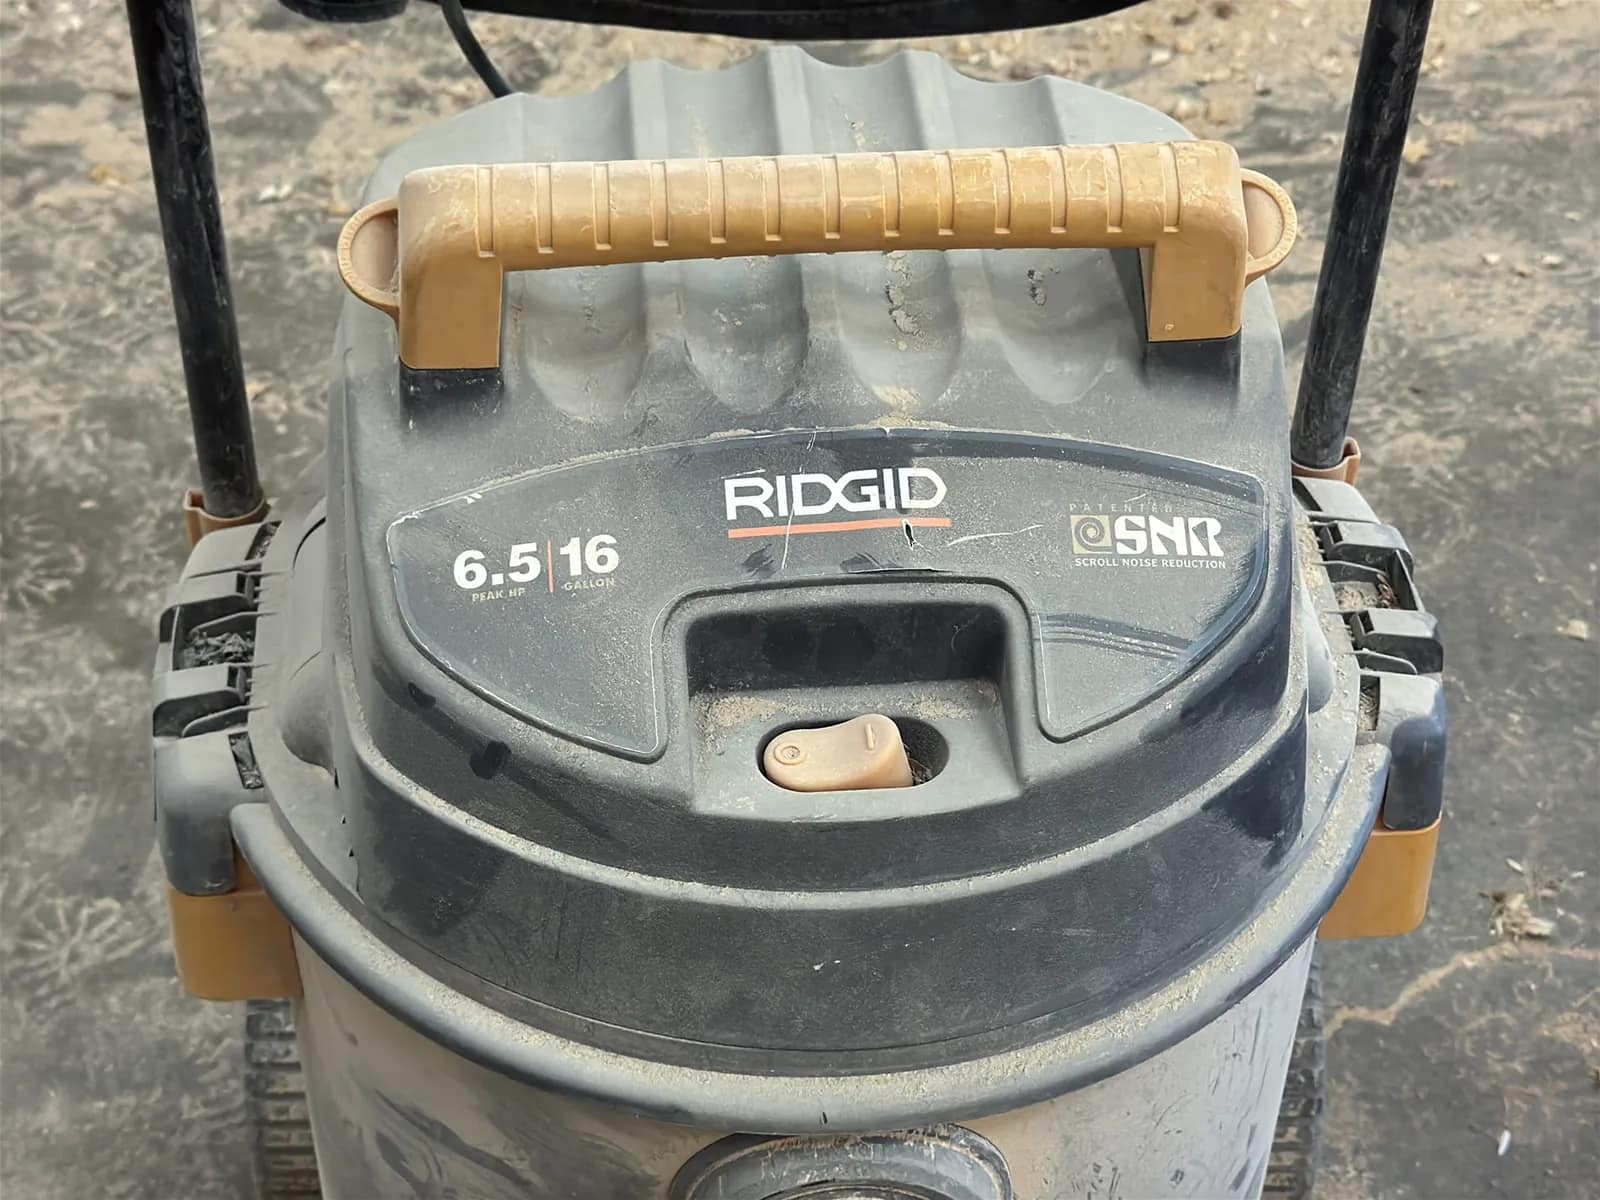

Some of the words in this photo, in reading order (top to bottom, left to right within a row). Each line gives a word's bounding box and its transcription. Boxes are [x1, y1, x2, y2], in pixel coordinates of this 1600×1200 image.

[724, 467, 948, 520] RIDGID
[1114, 515, 1224, 557] SNR
[453, 542, 541, 589] 6.5
[559, 534, 620, 576] 16
[1075, 558, 1119, 567] SCROLL
[1122, 559, 1159, 567] NOISE
[1161, 560, 1226, 569] REDUCTION
[472, 591, 504, 602] PEAK
[509, 587, 525, 598] HP
